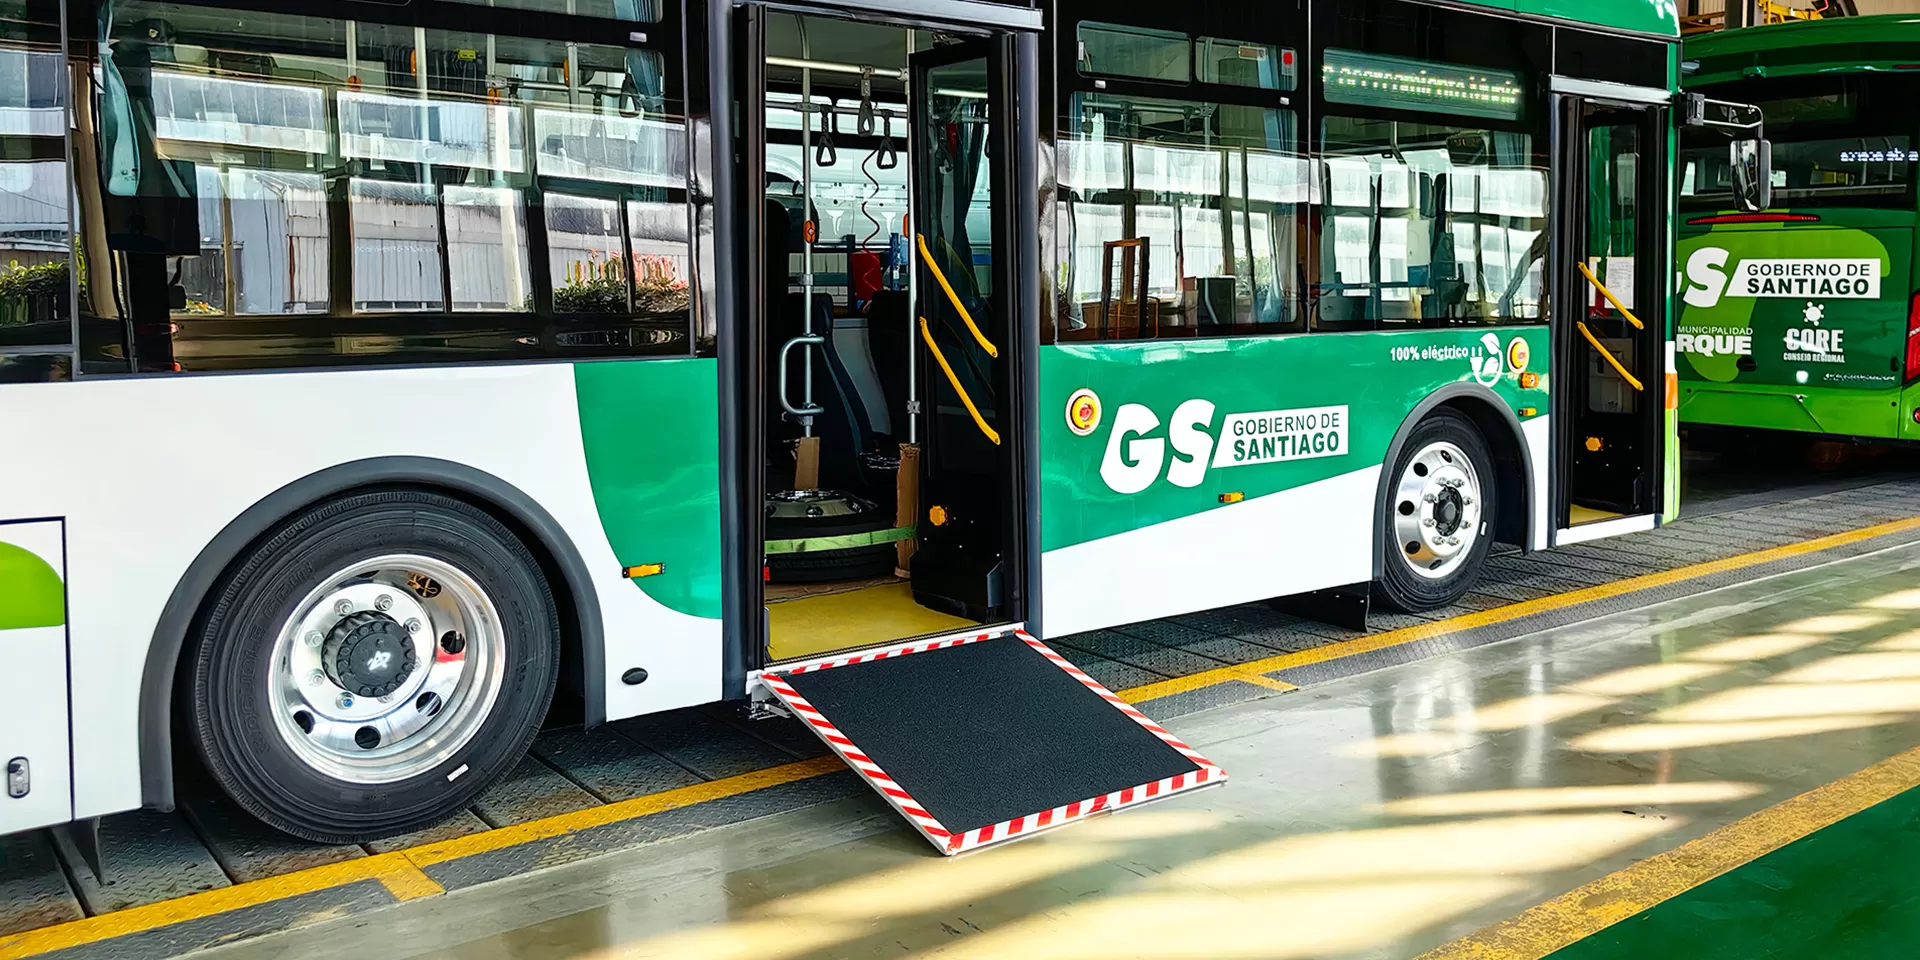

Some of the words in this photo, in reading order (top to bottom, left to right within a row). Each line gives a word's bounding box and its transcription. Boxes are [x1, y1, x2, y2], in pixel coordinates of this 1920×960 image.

[1676, 247, 1730, 308] S
[1747, 263, 1841, 276] GOBIERNO
[1847, 264, 1870, 276] DE
[1747, 278, 1869, 295] SANTIAGO
[1677, 326, 1753, 335] MUNICIPALIDAD
[1785, 328, 1844, 352] CORE
[1390, 346, 1420, 361] 100%
[1421, 345, 1469, 360] eléctrico
[1812, 352, 1845, 363] REGIONAL
[1233, 414, 1317, 436] GOBIERNO
[1321, 413, 1339, 428] DE
[1099, 398, 1216, 494] GS
[1233, 431, 1339, 461] SANTIAGO
